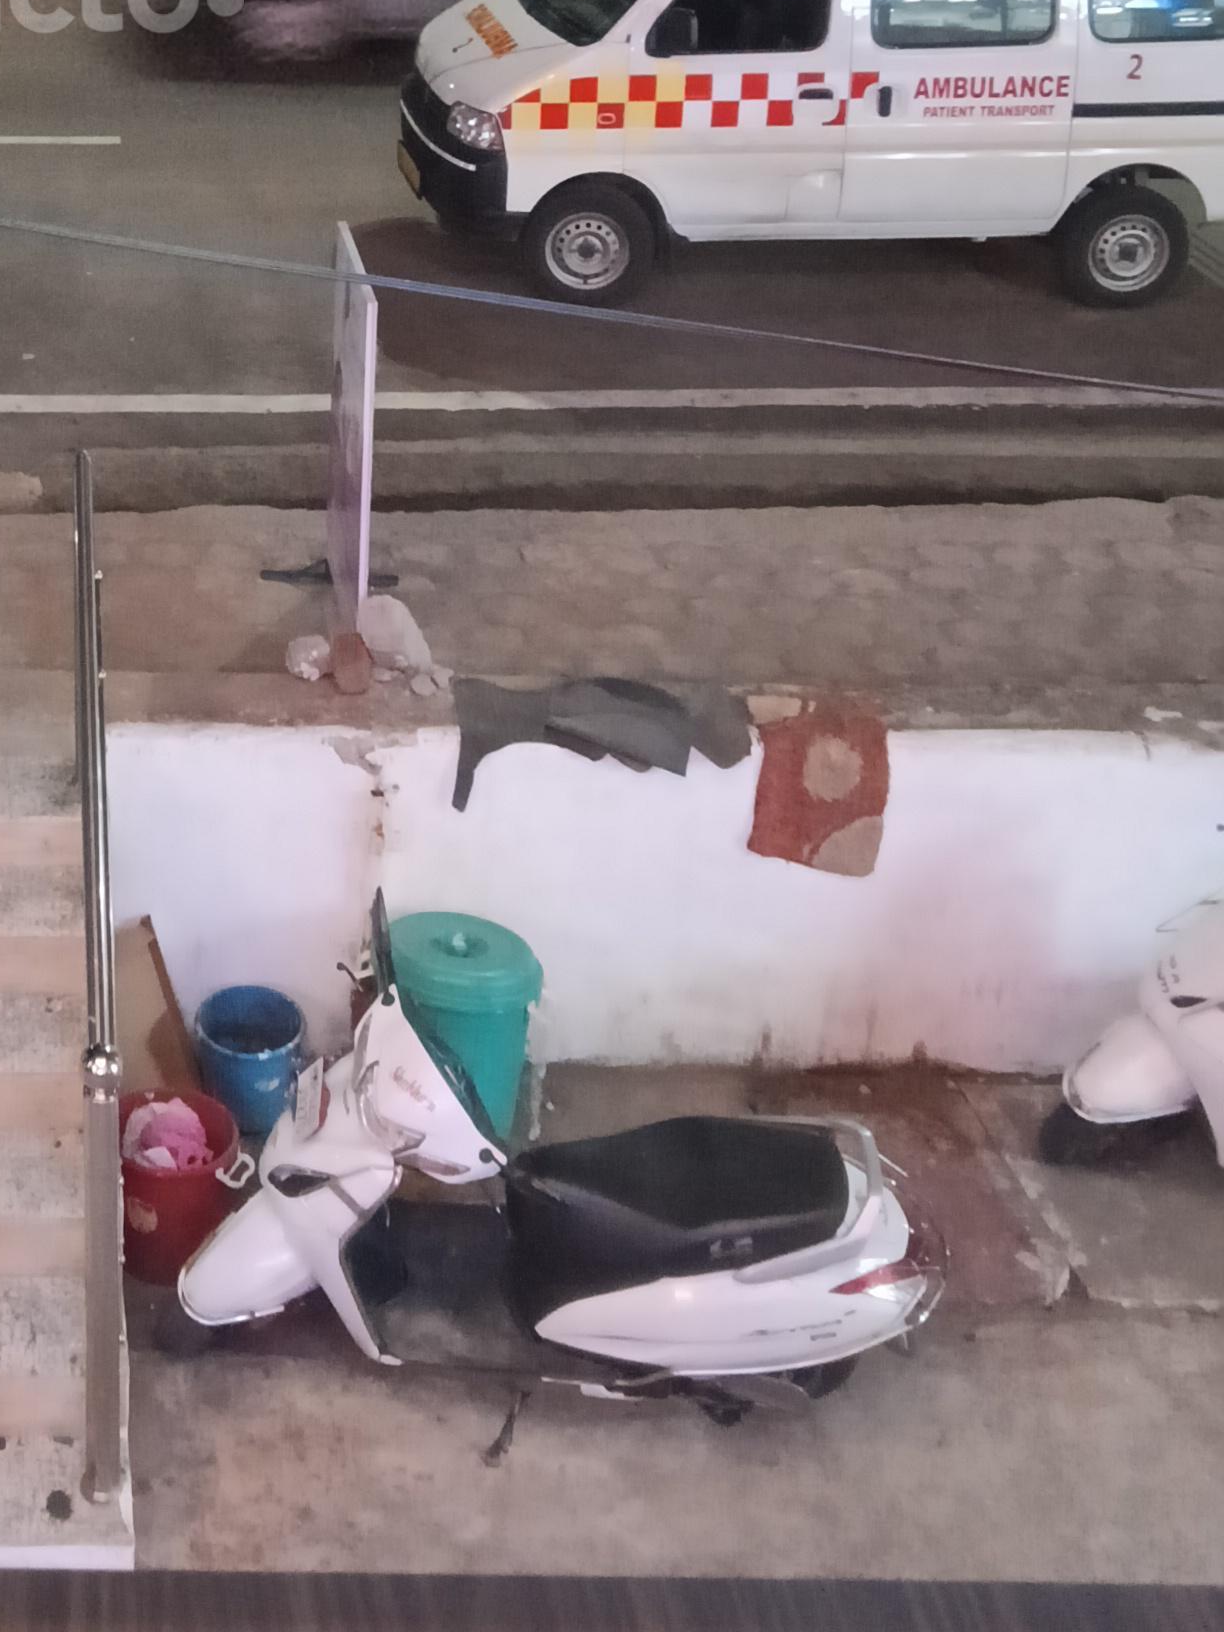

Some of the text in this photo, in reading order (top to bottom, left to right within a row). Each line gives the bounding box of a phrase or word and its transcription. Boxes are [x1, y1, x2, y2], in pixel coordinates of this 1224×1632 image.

[1126, 53, 1144, 80] 2
[913, 75, 1071, 100] AMBULANCE
[923, 104, 1055, 118] PATIENT TRANSPORT
